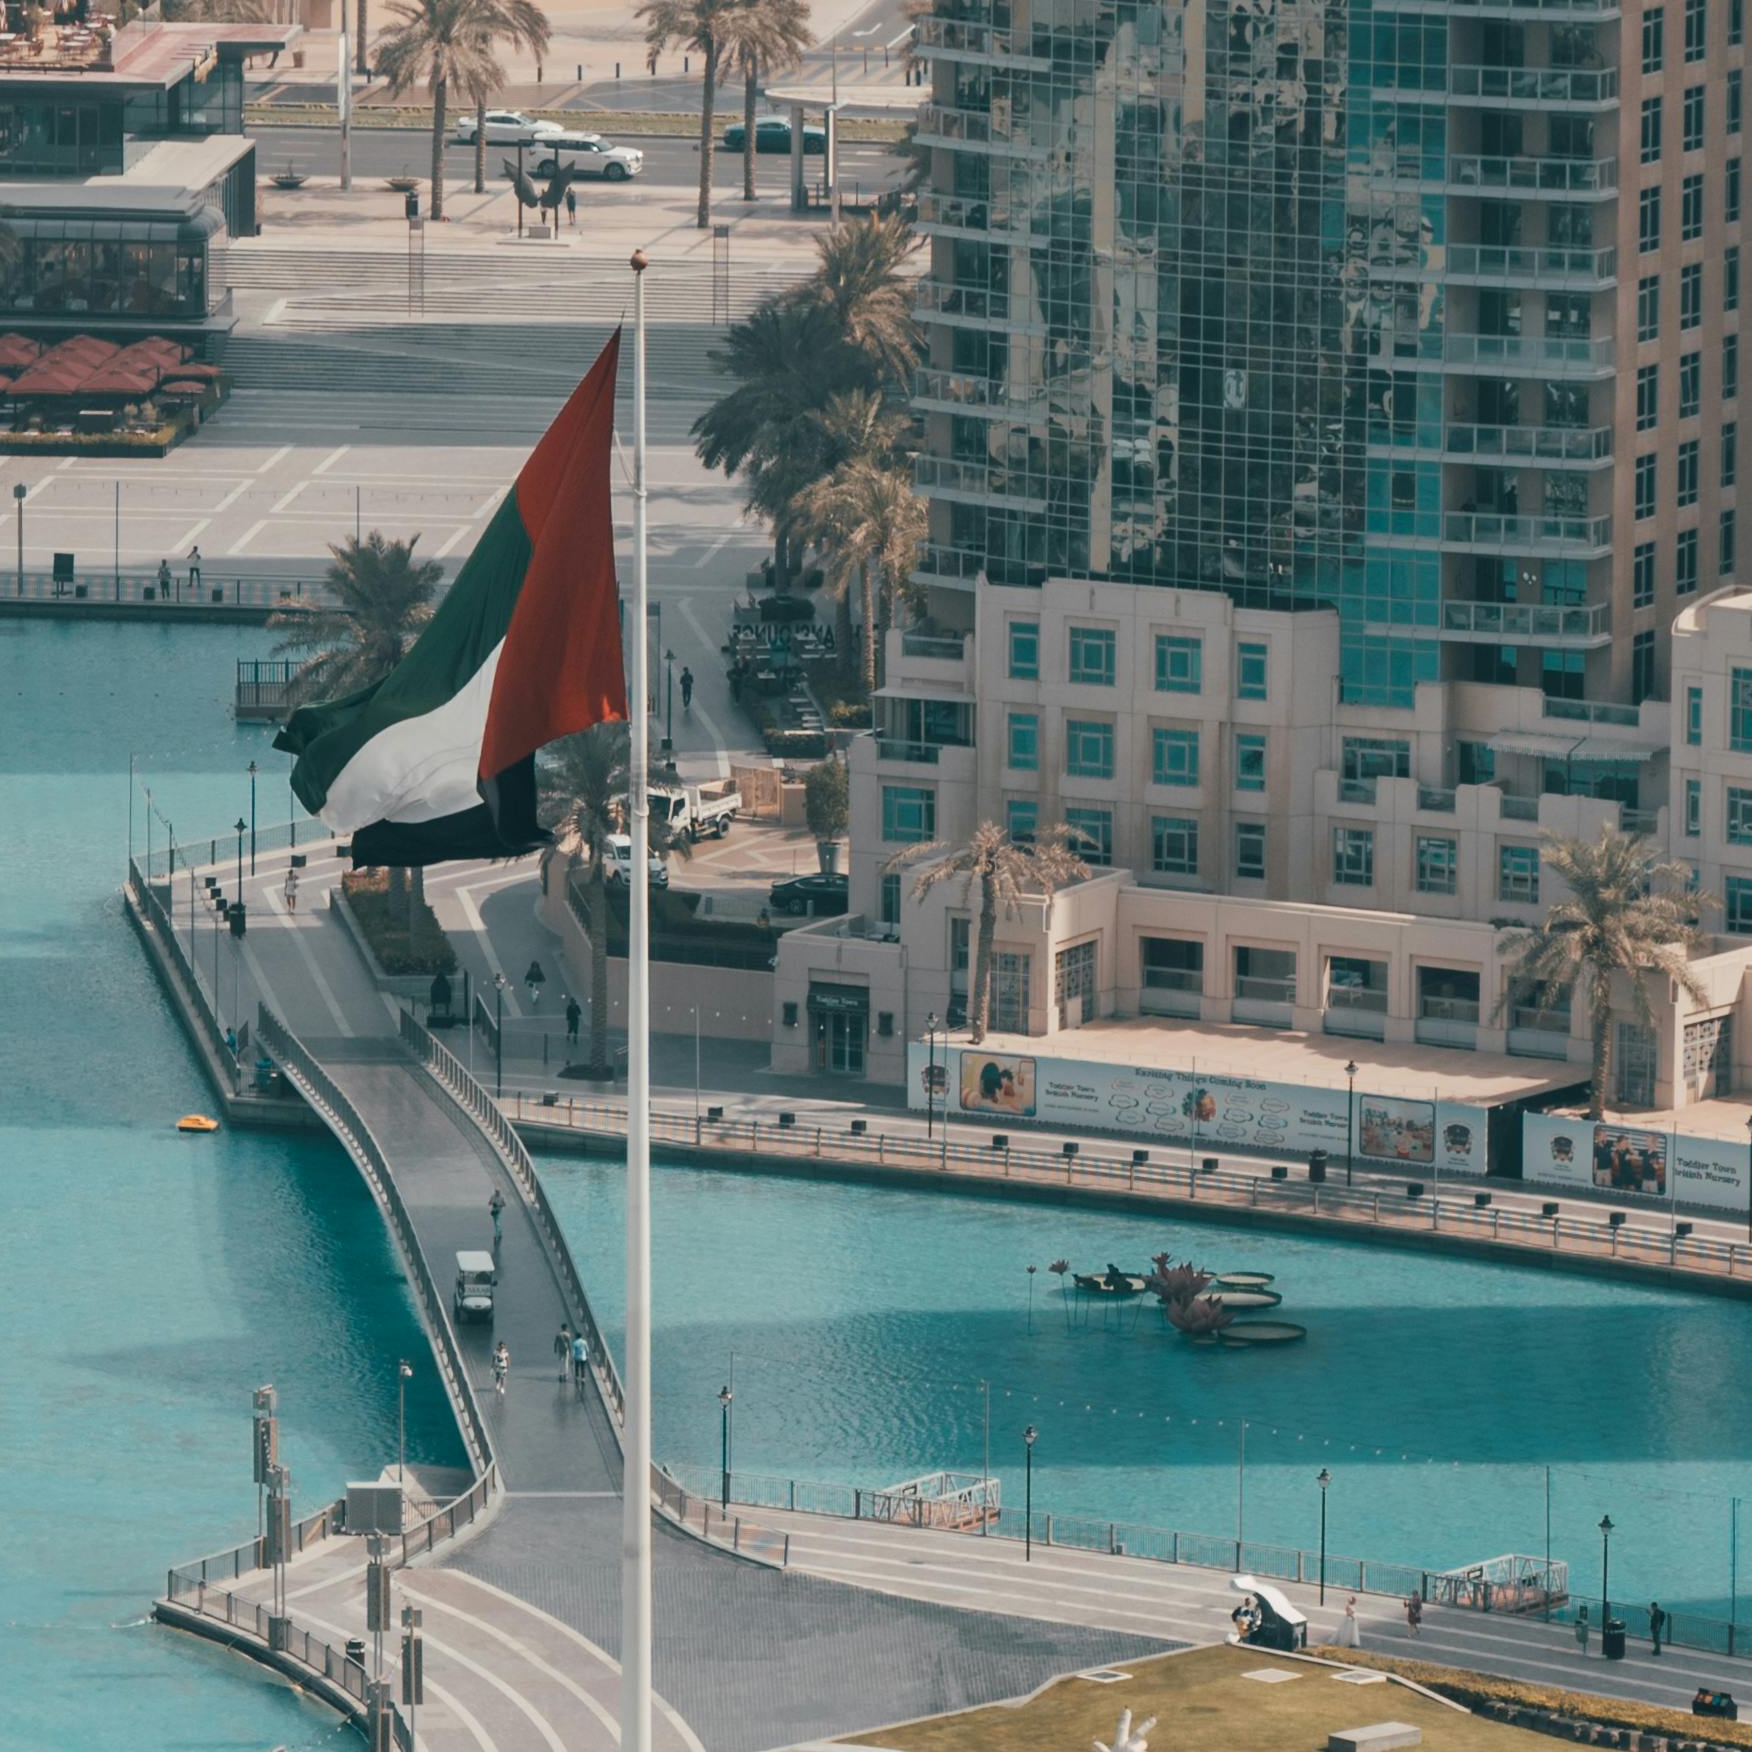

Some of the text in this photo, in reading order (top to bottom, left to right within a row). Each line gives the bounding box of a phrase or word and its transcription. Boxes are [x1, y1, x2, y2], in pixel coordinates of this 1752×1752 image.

[1209, 1075, 1242, 1089] Coming
[1245, 1079, 1267, 1090] Soon
[1677, 1156, 1736, 1175] Toddler Town
[1705, 1171, 1741, 1188] Nursery
